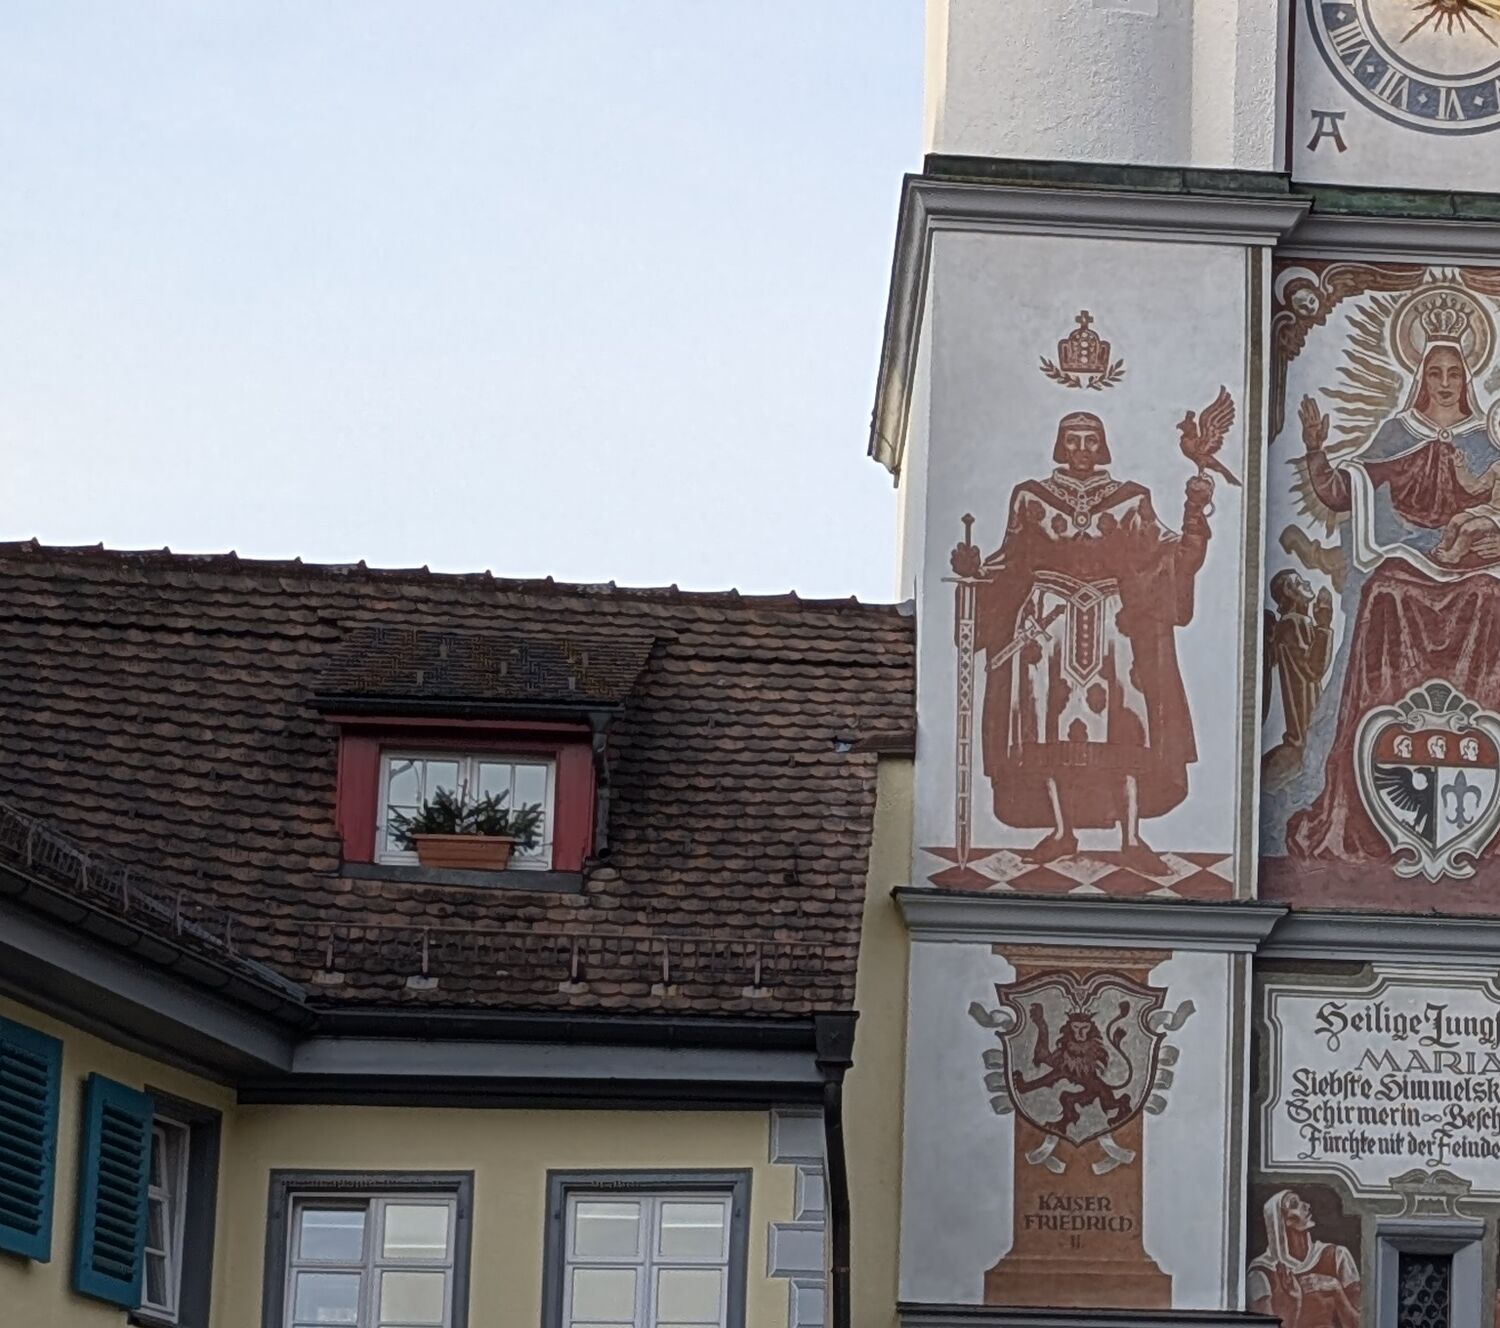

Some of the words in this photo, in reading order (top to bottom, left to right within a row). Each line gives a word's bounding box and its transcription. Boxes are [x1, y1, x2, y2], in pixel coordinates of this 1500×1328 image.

[1327, 19, 1372, 75] VIII
[1370, 64, 1411, 112] VII
[1435, 87, 1468, 121] VI
[1314, 1001, 1422, 1052] Heilige
[1285, 1097, 1421, 1129] Schirmerin
[1407, 1131, 1436, 1156] der
[1426, 1129, 1500, 1167] Feinde
[1038, 1192, 1112, 1212] KAISER
